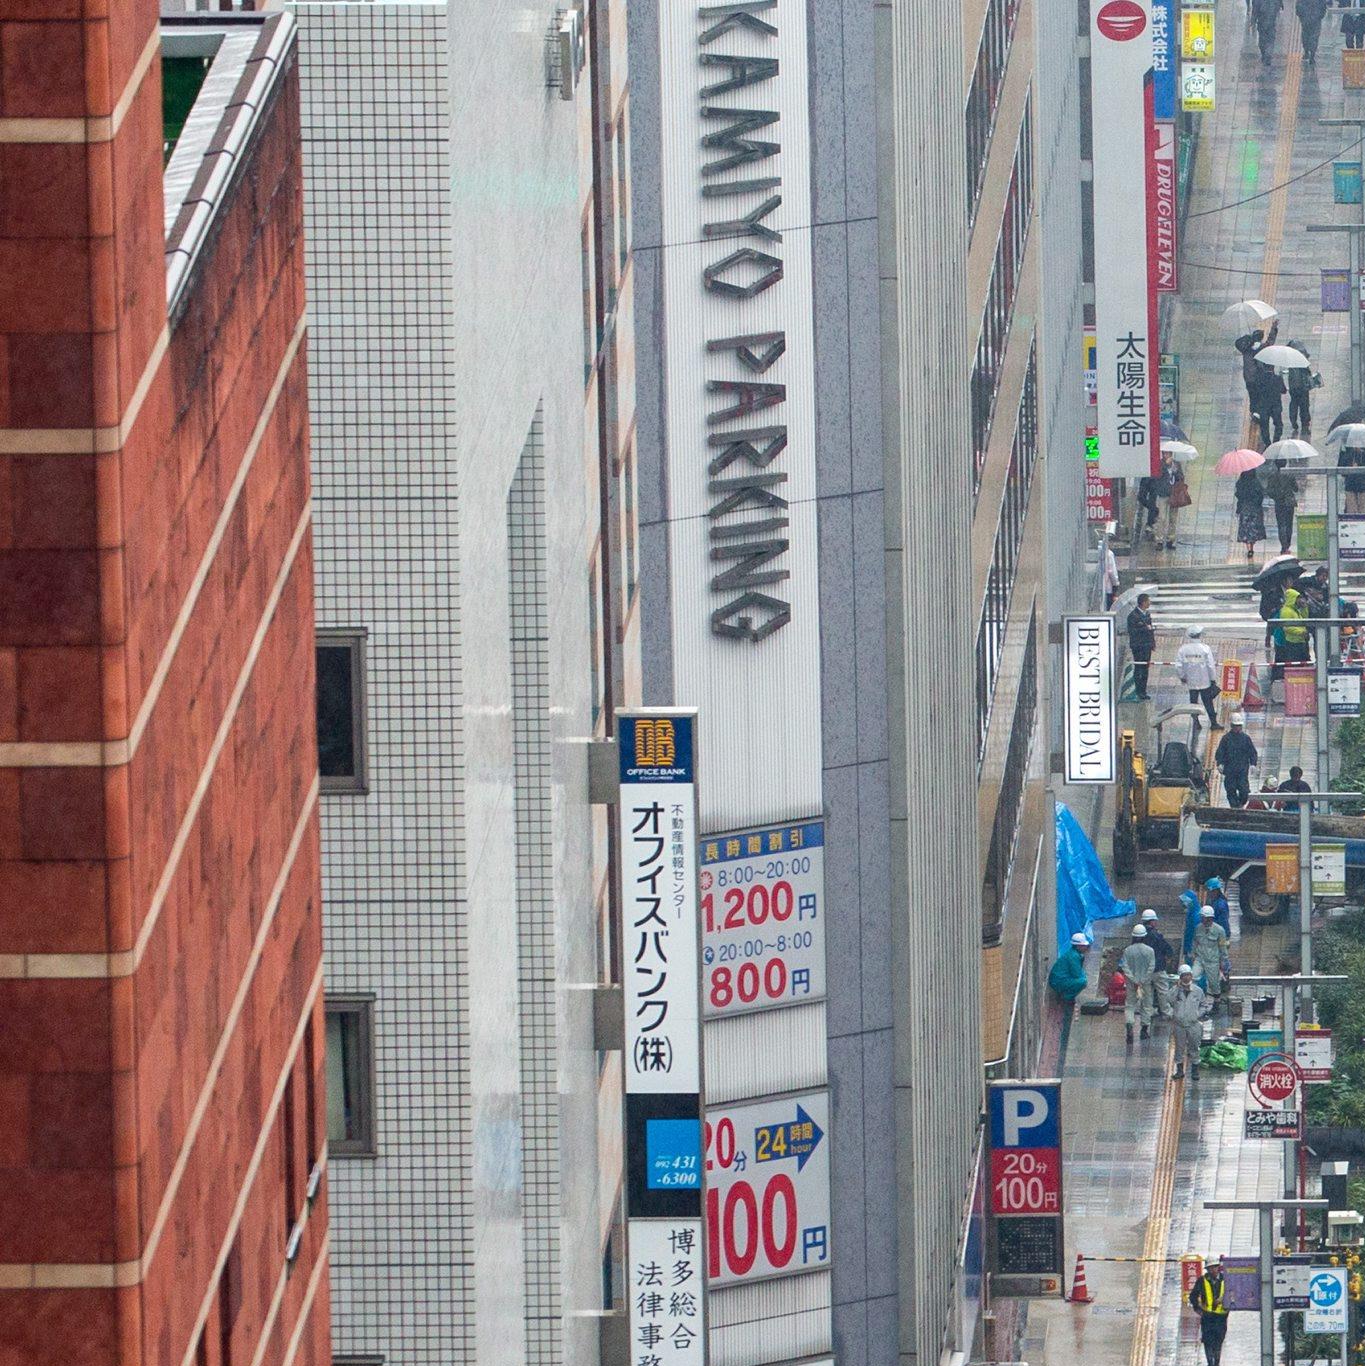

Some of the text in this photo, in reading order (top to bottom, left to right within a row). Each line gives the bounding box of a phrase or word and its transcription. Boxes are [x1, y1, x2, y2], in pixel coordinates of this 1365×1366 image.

[1116, 331, 1146, 447] 太陽生命
[707, 331, 791, 643] PARKING
[1077, 627, 1102, 776] BEST BRIDAL
[626, 768, 659, 776] OFFICE
[671, 803, 685, 920] 不動産情報センター
[704, 828, 805, 860] 長時間割引
[1260, 1073, 1293, 1089] 消火栓
[1003, 1090, 1048, 1145] P
[1247, 1111, 1297, 1125] とみや歯科
[757, 1126, 787, 1161] 24
[671, 1156, 696, 1169] 431
[1003, 1153, 1047, 1175] 20分
[669, 1228, 697, 1350] 博多総合
